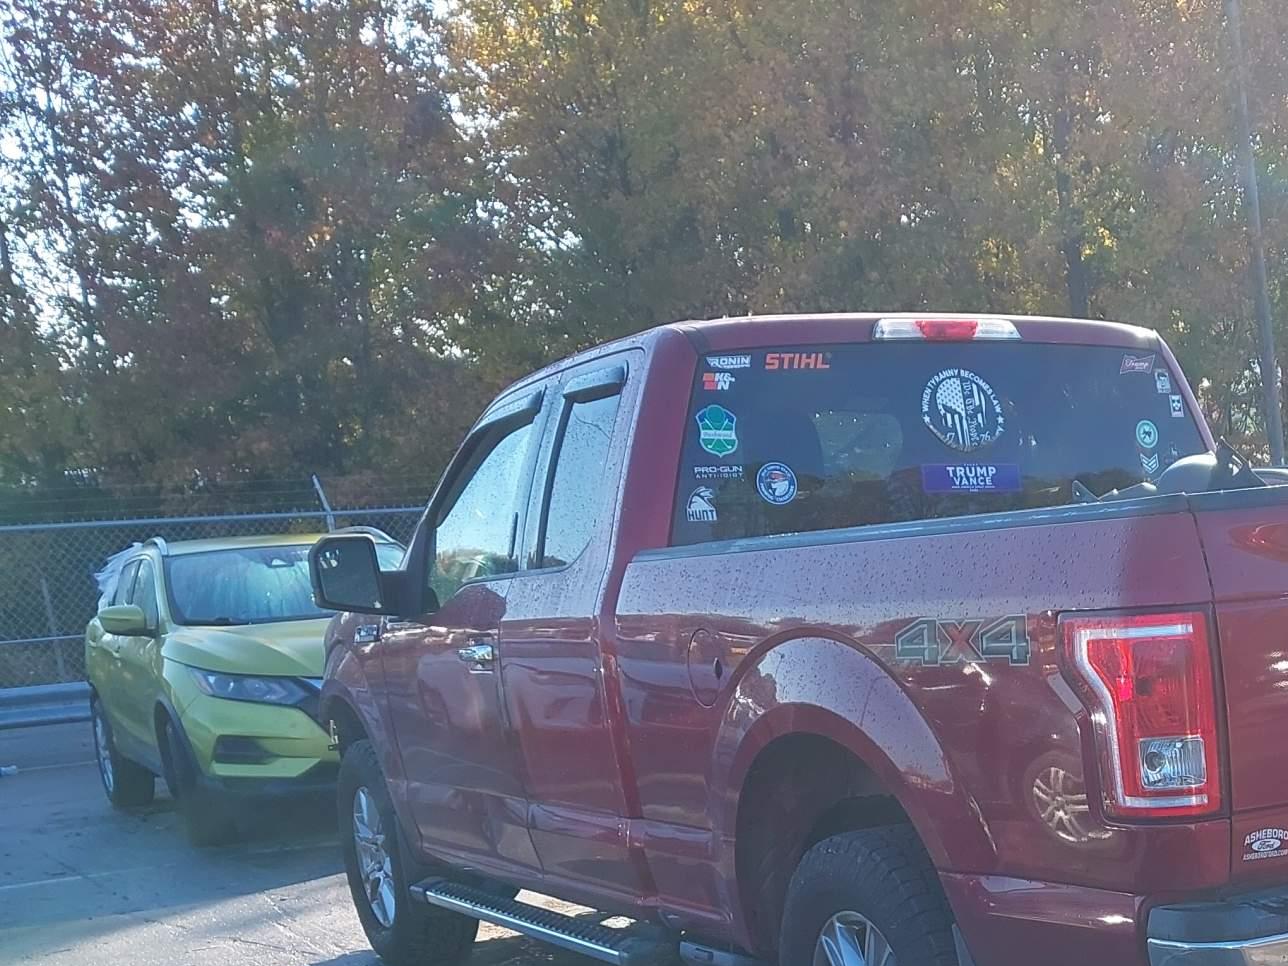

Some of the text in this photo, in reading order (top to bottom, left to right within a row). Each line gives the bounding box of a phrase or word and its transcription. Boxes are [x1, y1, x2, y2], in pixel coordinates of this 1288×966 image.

[765, 353, 830, 369] STIHL
[922, 369, 1003, 414] WHEN TYRANNY BECOMES LAW
[694, 465, 743, 474] PRO-GUN
[946, 466, 997, 478] TRUMP
[953, 476, 993, 486] VANCE
[687, 508, 718, 521] HUNT
